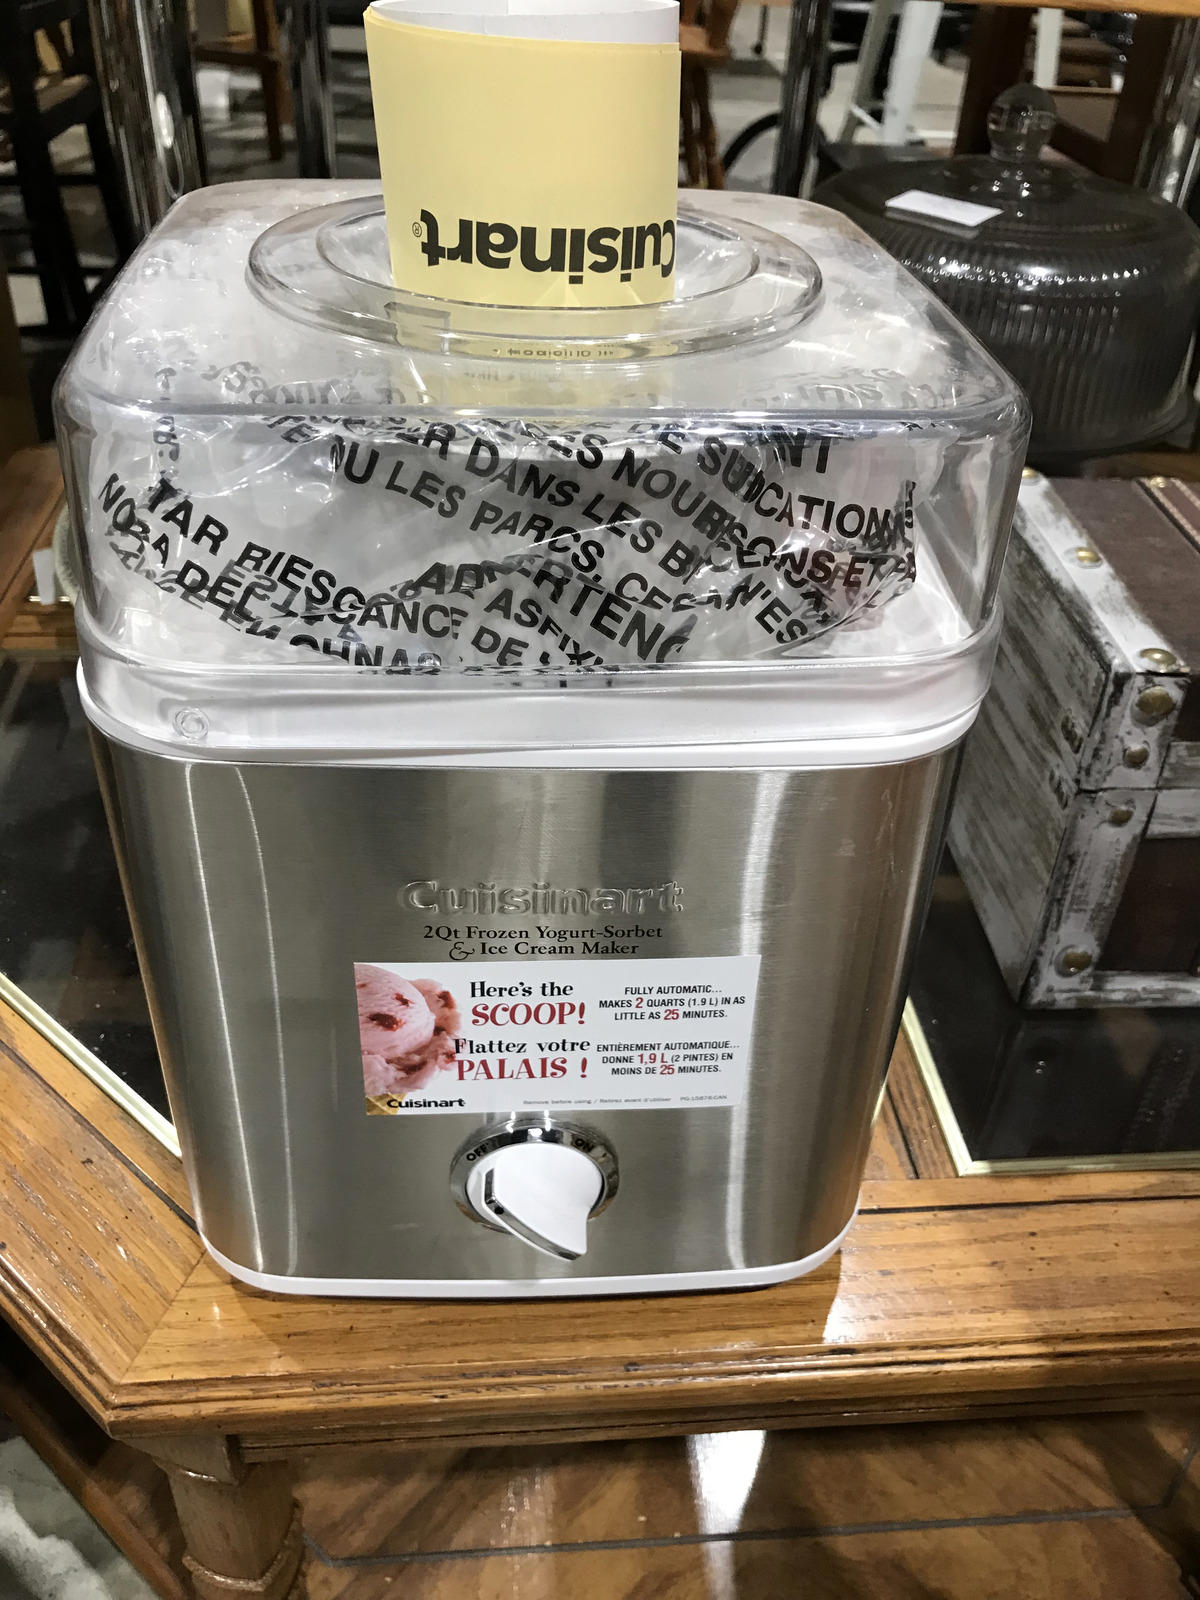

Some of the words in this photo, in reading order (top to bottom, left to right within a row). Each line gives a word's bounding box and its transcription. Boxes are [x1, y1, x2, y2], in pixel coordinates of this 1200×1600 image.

[384, 460, 467, 519] LES
[464, 436, 581, 508] DANS
[582, 493, 663, 554] LES
[403, 880, 685, 916] Cuisinart
[423, 925, 461, 942] 2Qt
[466, 926, 530, 939] Frozen
[536, 924, 663, 943] Yogurt-Sorbet
[449, 942, 475, 961] &
[481, 943, 508, 955] Ice
[514, 943, 575, 955] Cream
[581, 941, 640, 955] Maker
[470, 981, 532, 998] Here's
[540, 982, 574, 998] the
[624, 986, 654, 995] FULLY
[599, 1000, 632, 1008] MAKES
[635, 997, 643, 1009] 2
[646, 998, 685, 1008] QUARTS
[721, 996, 731, 1005] IN
[732, 996, 745, 1005] AS
[471, 1001, 586, 1027] SCOOP!
[614, 1012, 646, 1021] LITTLE
[647, 1011, 661, 1020] AS
[663, 1009, 679, 1020] 25
[682, 1009, 728, 1019] MINUTES.
[453, 1038, 527, 1055] Flattez
[537, 1038, 591, 1053] votre
[602, 1055, 635, 1064] DONNE
[638, 1053, 657, 1065] 1,9
[660, 1053, 668, 1063] L
[683, 1053, 719, 1062] PINTES)
[721, 1052, 733, 1060] EN
[456, 1057, 568, 1081] PALAIS
[580, 1057, 588, 1079] !
[611, 1067, 642, 1075] MOINS
[645, 1066, 657, 1075] DE
[659, 1065, 675, 1075] 25
[677, 1064, 722, 1074] MINUTES.
[386, 1098, 466, 1109] Cuisinart
[466, 1143, 488, 1162] OFF
[574, 1137, 595, 1153] ON
